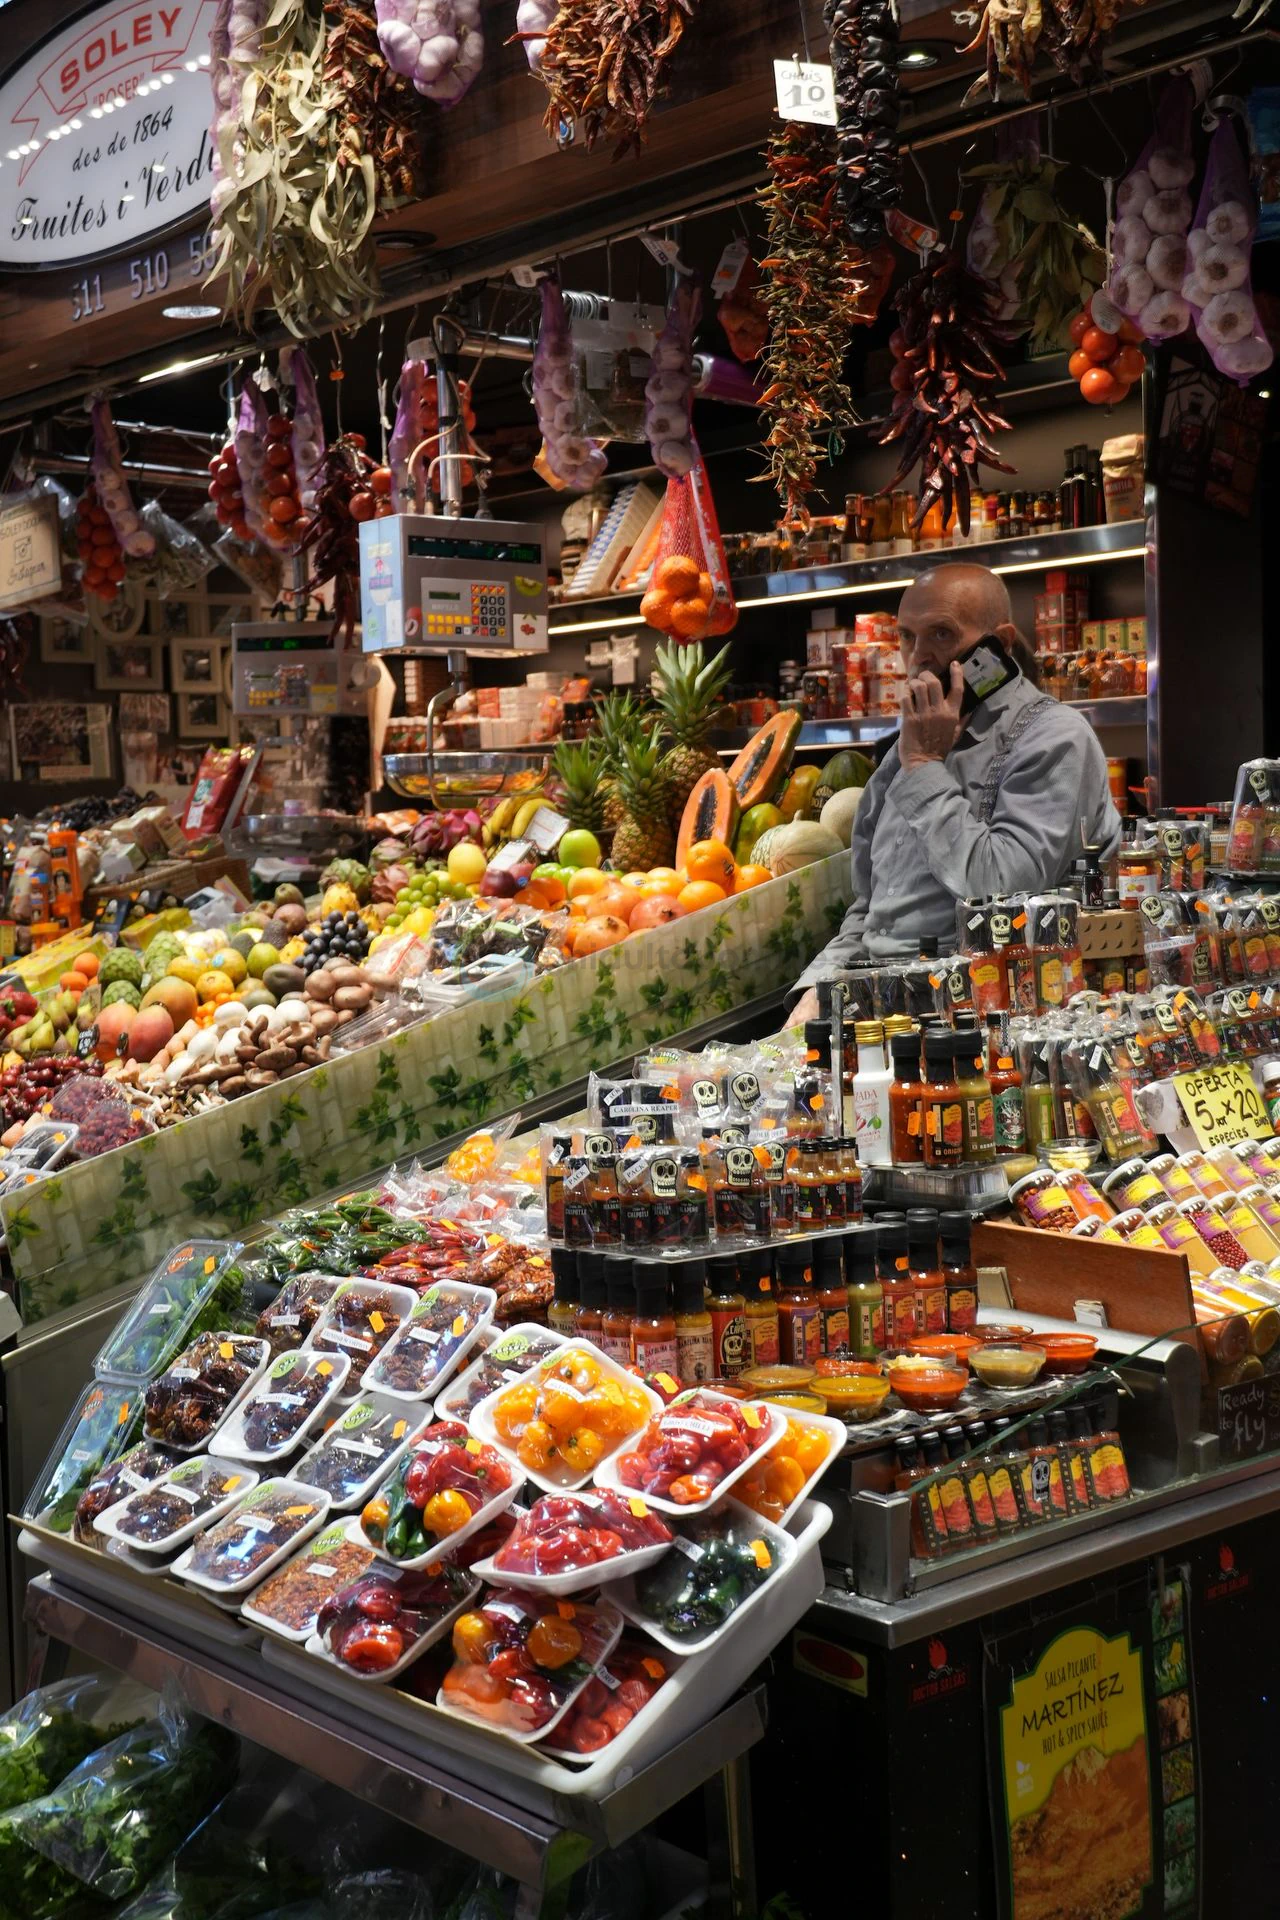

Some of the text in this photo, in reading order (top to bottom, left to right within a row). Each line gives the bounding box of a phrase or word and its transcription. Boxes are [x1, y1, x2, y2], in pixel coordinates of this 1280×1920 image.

[60, 7, 182, 95] SOLEY
[107, 131, 128, 156] de
[133, 105, 173, 146] 1864
[11, 192, 107, 242] Fruites
[117, 180, 131, 220] i
[130, 251, 169, 299] 510
[1185, 1070, 1243, 1097] OFERTA
[651, 1104, 678, 1112] REAPER
[1234, 1088, 1260, 1121] 20
[567, 1170, 586, 1185] PACK
[625, 1163, 645, 1178] PACK
[1222, 1384, 1264, 1411] Ready
[1233, 1411, 1266, 1453] fly
[1045, 1653, 1097, 1690] SALSA PICANTE
[1021, 1672, 1124, 1738] MARTÍNEZ
[1042, 1734, 1057, 1755] HOT
[1066, 1722, 1086, 1745] SPICY
[1087, 1711, 1109, 1734] SAUCE
